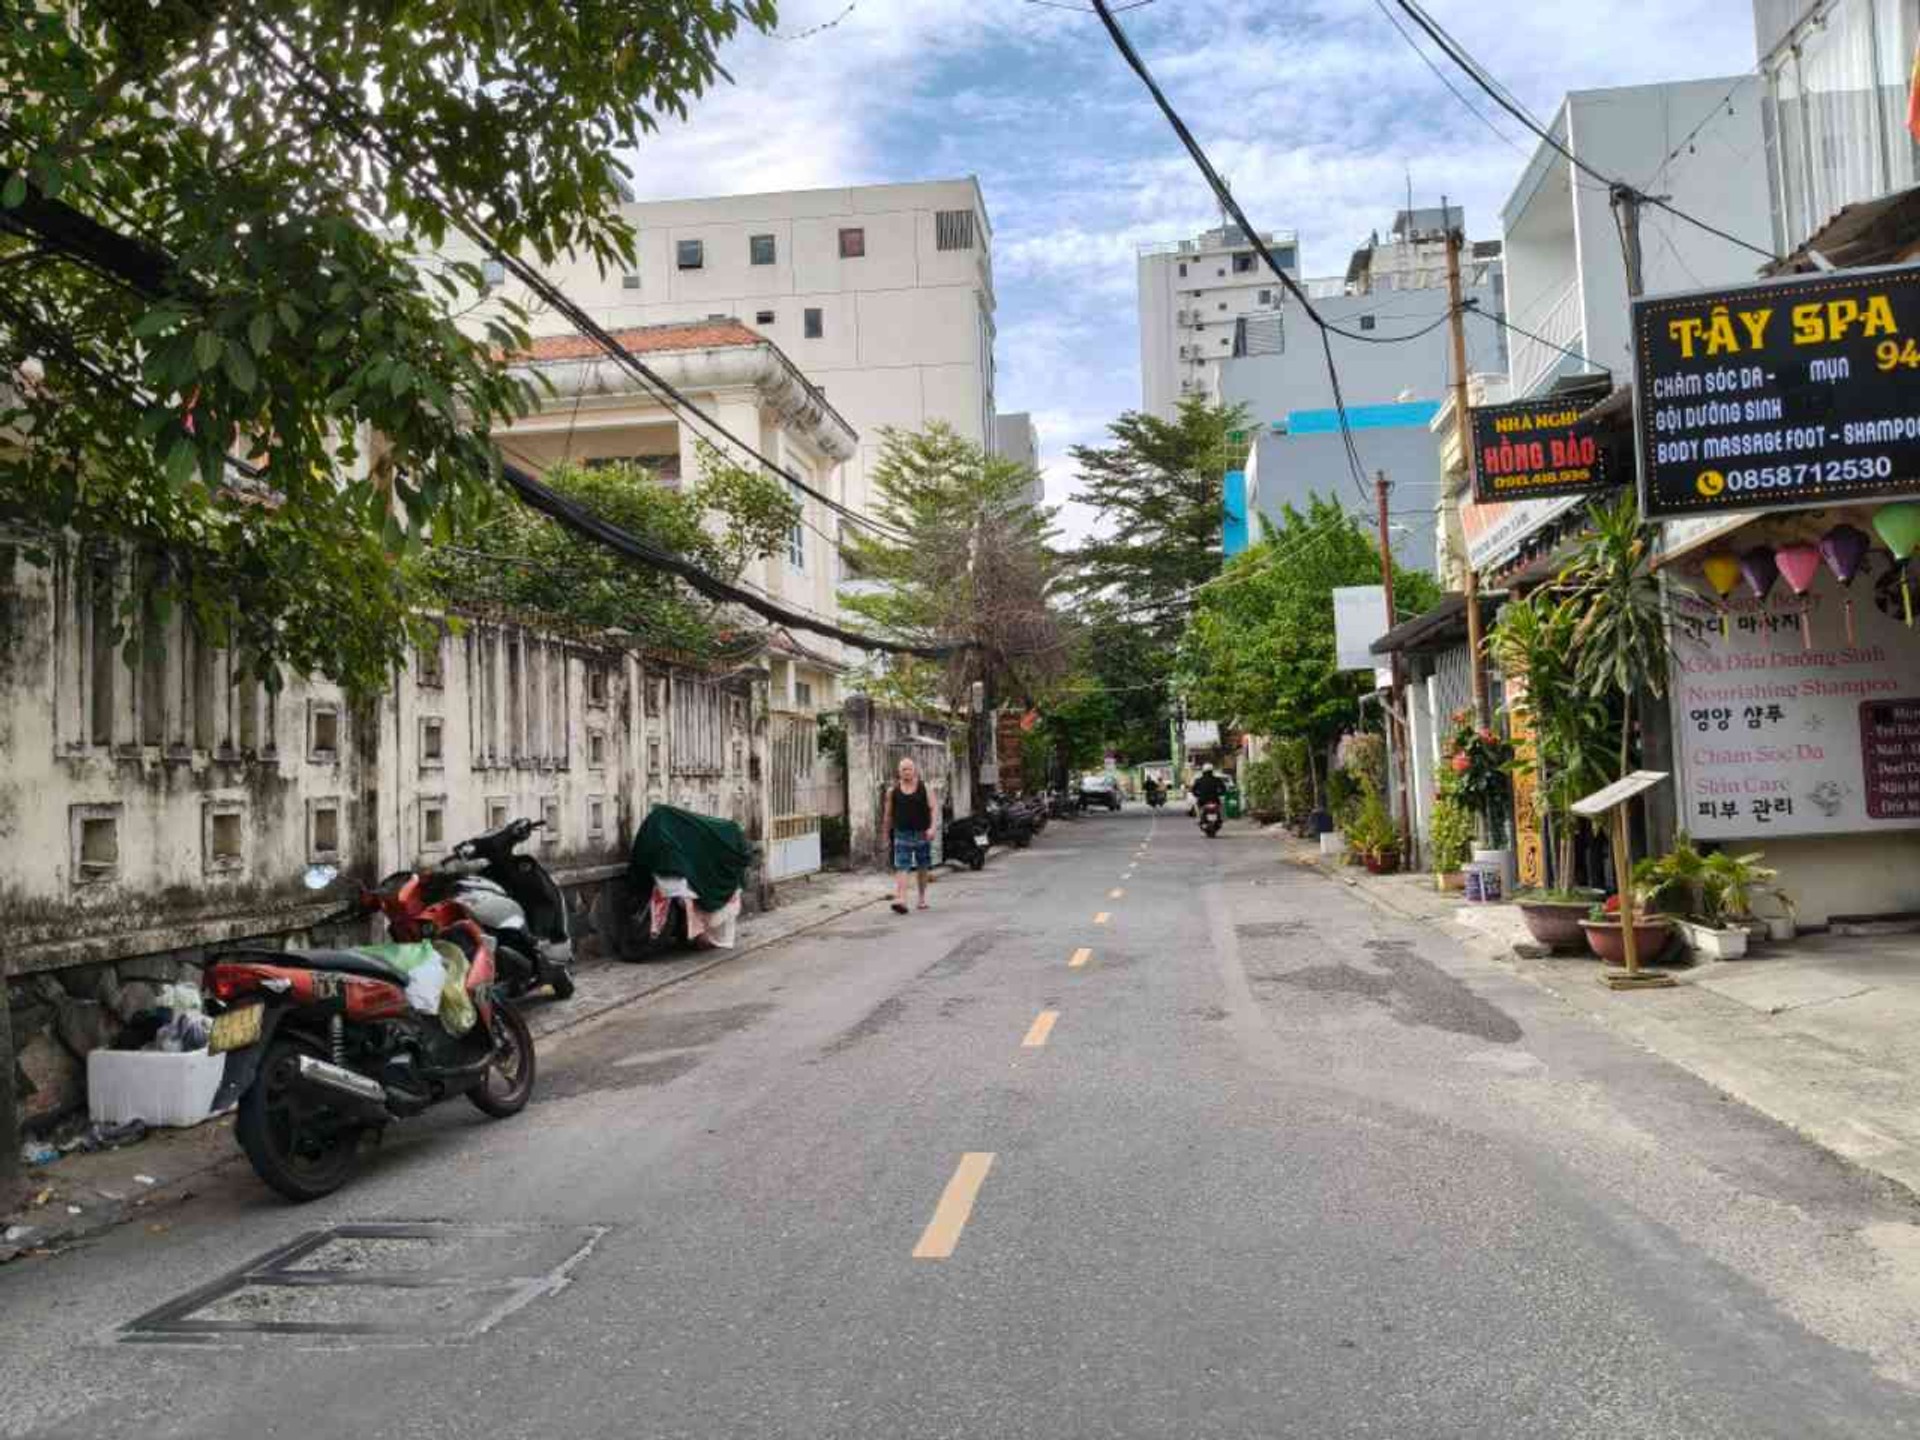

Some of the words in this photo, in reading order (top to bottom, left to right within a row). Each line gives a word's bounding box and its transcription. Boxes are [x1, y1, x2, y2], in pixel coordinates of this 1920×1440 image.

[1668, 305, 1773, 359] TÂY
[1792, 294, 1898, 345] SPA
[1705, 366, 1737, 393] SÓC
[1741, 366, 1763, 388] DA
[1745, 397, 1782, 421] SINH
[1657, 440, 1699, 464] BODY
[1703, 430, 1782, 459] MASSAGE
[1786, 426, 1825, 449] FOOT
[1844, 415, 1920, 445] SHAMPO
[1727, 456, 1892, 492] 0858712530
[1688, 681, 1798, 701] Nourishing
[1799, 677, 1897, 698] Shampoo
[1690, 708, 1733, 731] 영양
[1743, 704, 1785, 730] 샴푸
[1698, 799, 1739, 820] 피부
[1752, 797, 1793, 823] 관리
